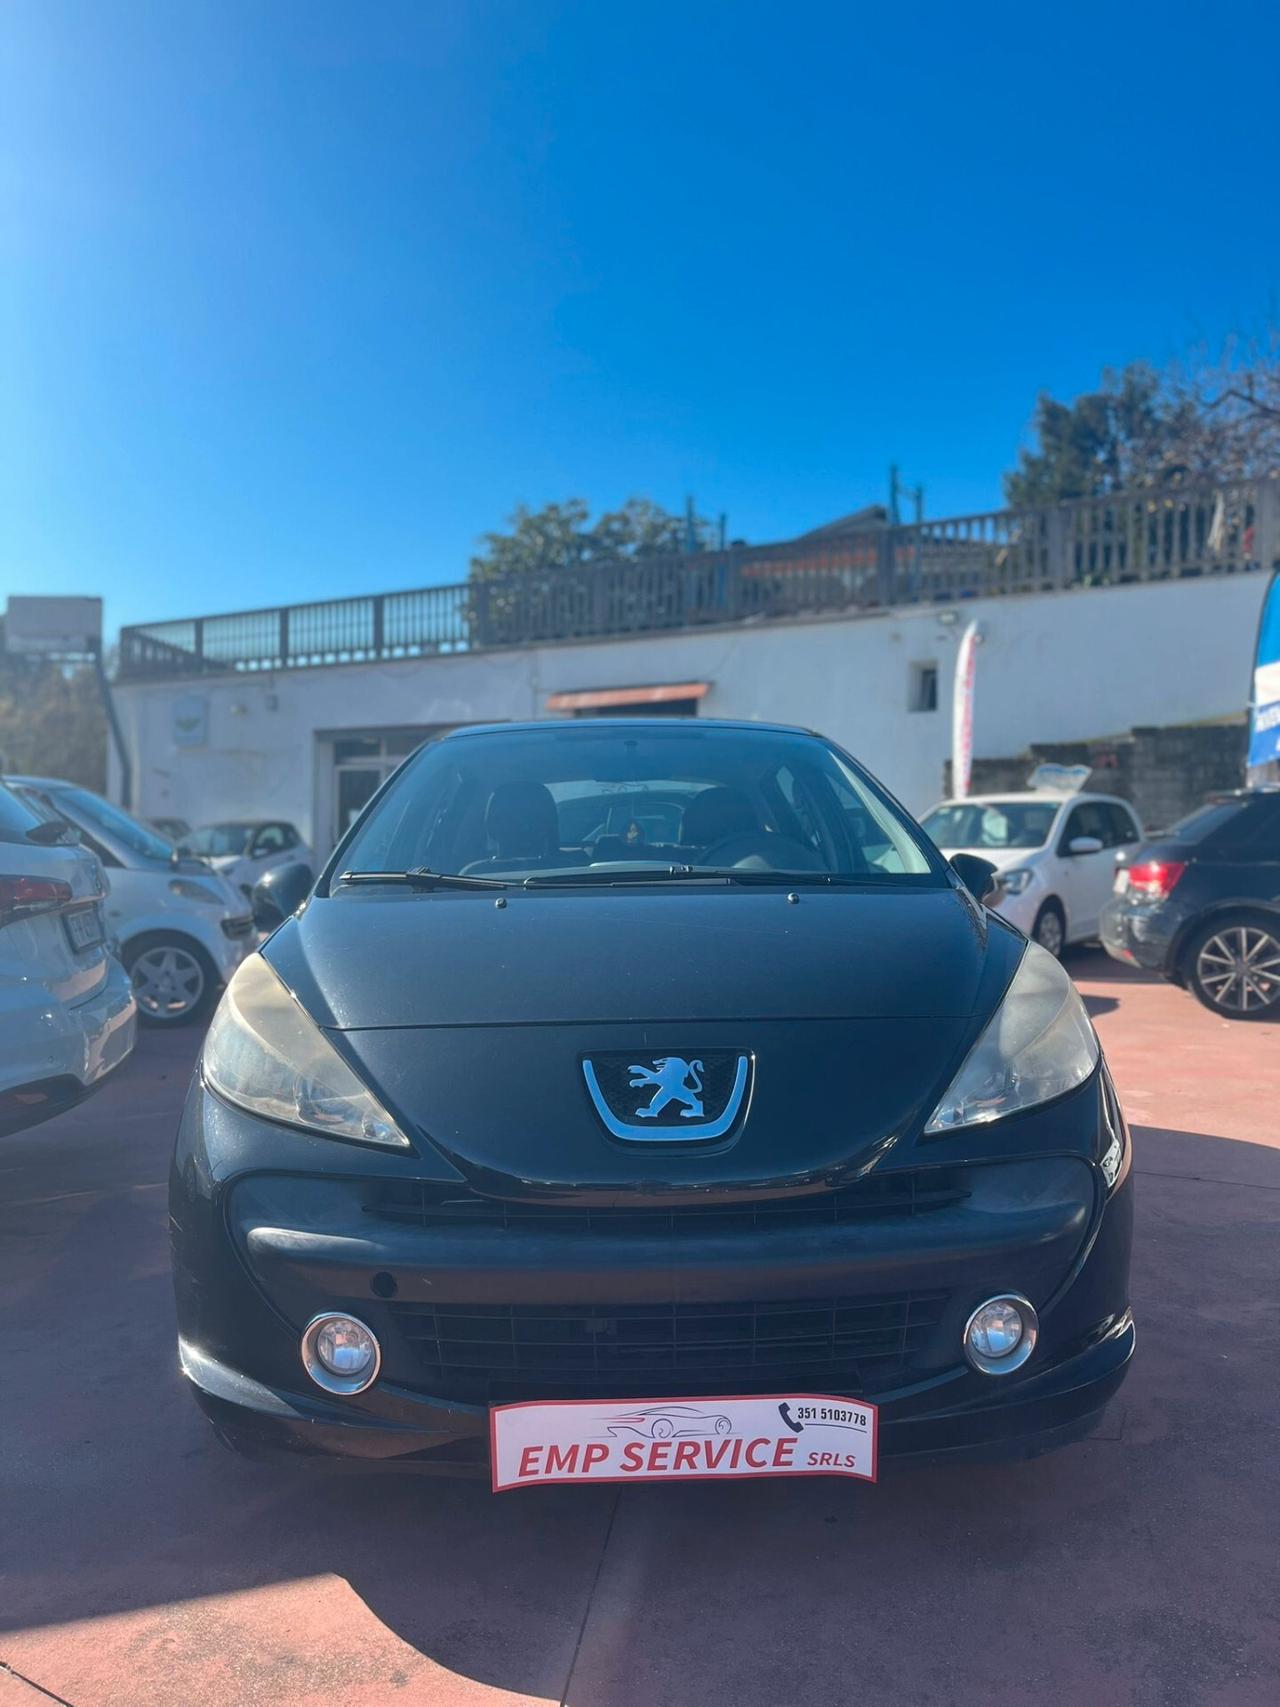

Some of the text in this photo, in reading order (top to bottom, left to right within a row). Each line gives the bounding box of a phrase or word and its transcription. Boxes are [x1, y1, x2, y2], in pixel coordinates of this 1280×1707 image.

[798, 1407, 866, 1426] 351 5103778
[518, 1437, 856, 1477] EMP SERVICE SRLS
